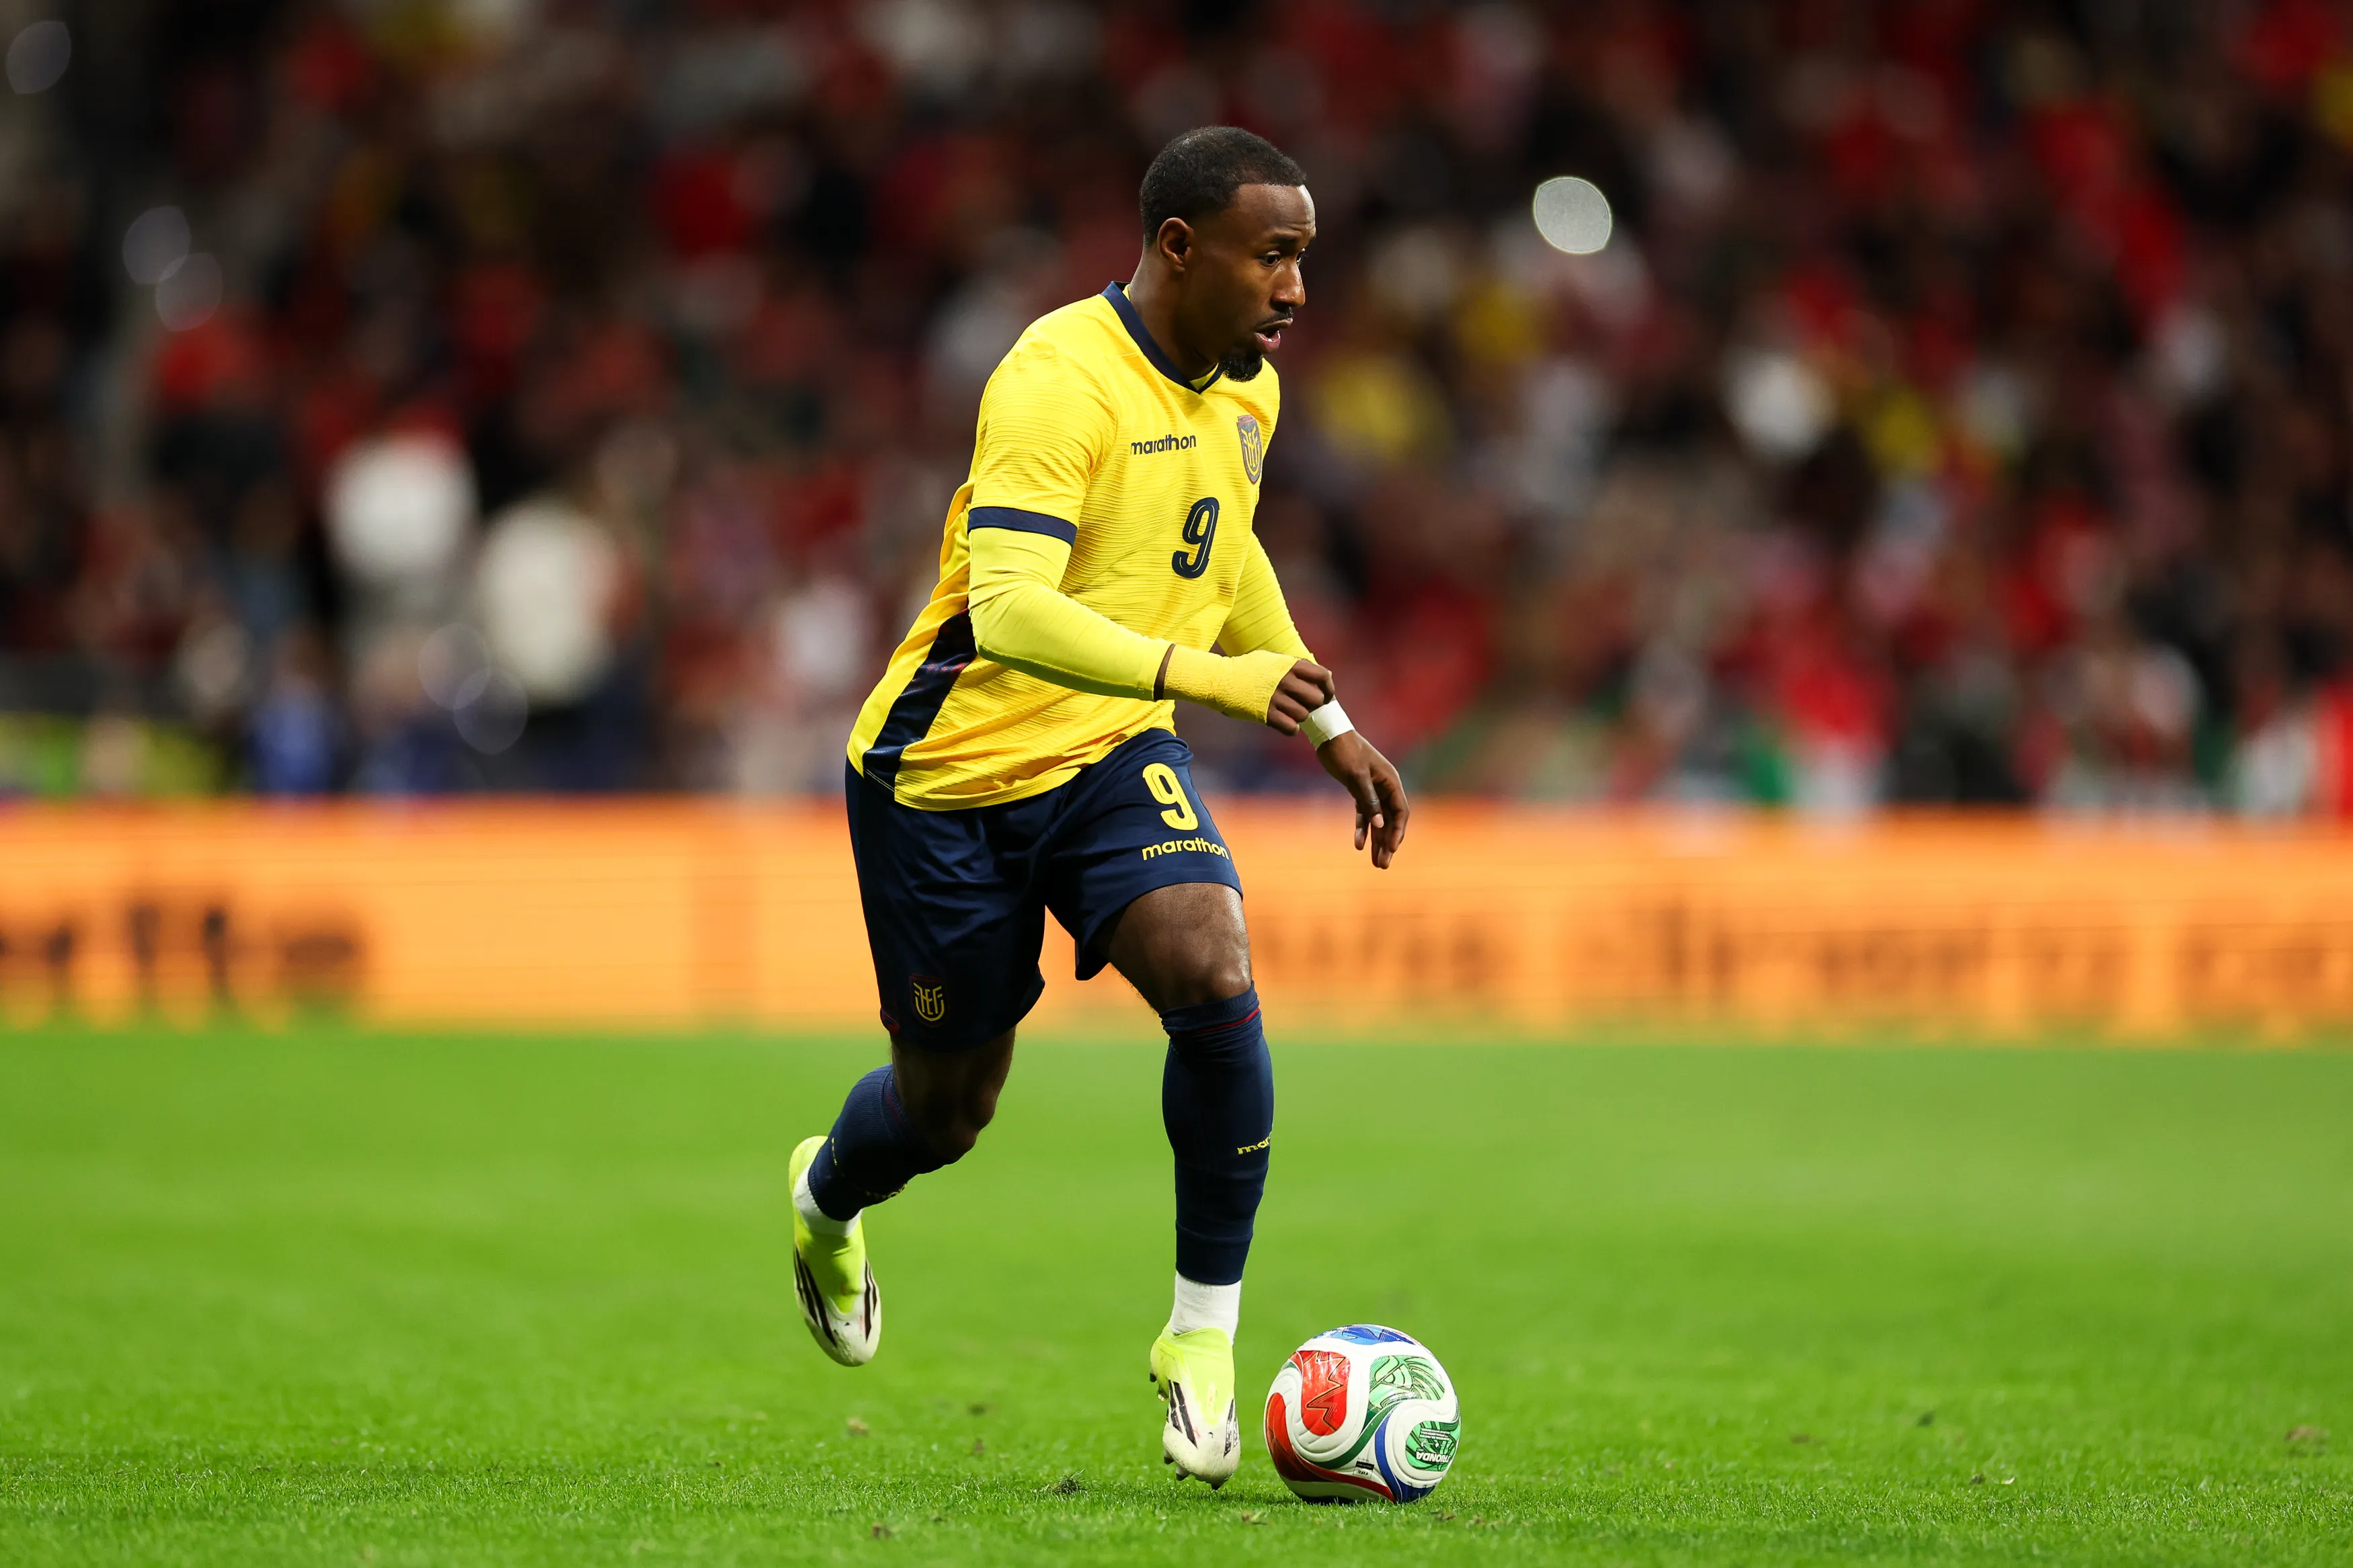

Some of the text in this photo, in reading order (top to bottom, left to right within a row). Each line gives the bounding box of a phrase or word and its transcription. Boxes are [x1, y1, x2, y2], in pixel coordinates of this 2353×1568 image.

[1131, 434, 1197, 455] marathon
[1171, 497, 1220, 579] 9
[1142, 762, 1199, 831] 9
[1142, 836, 1230, 861] marathon
[1416, 1451, 1450, 1463] TRIONDA
